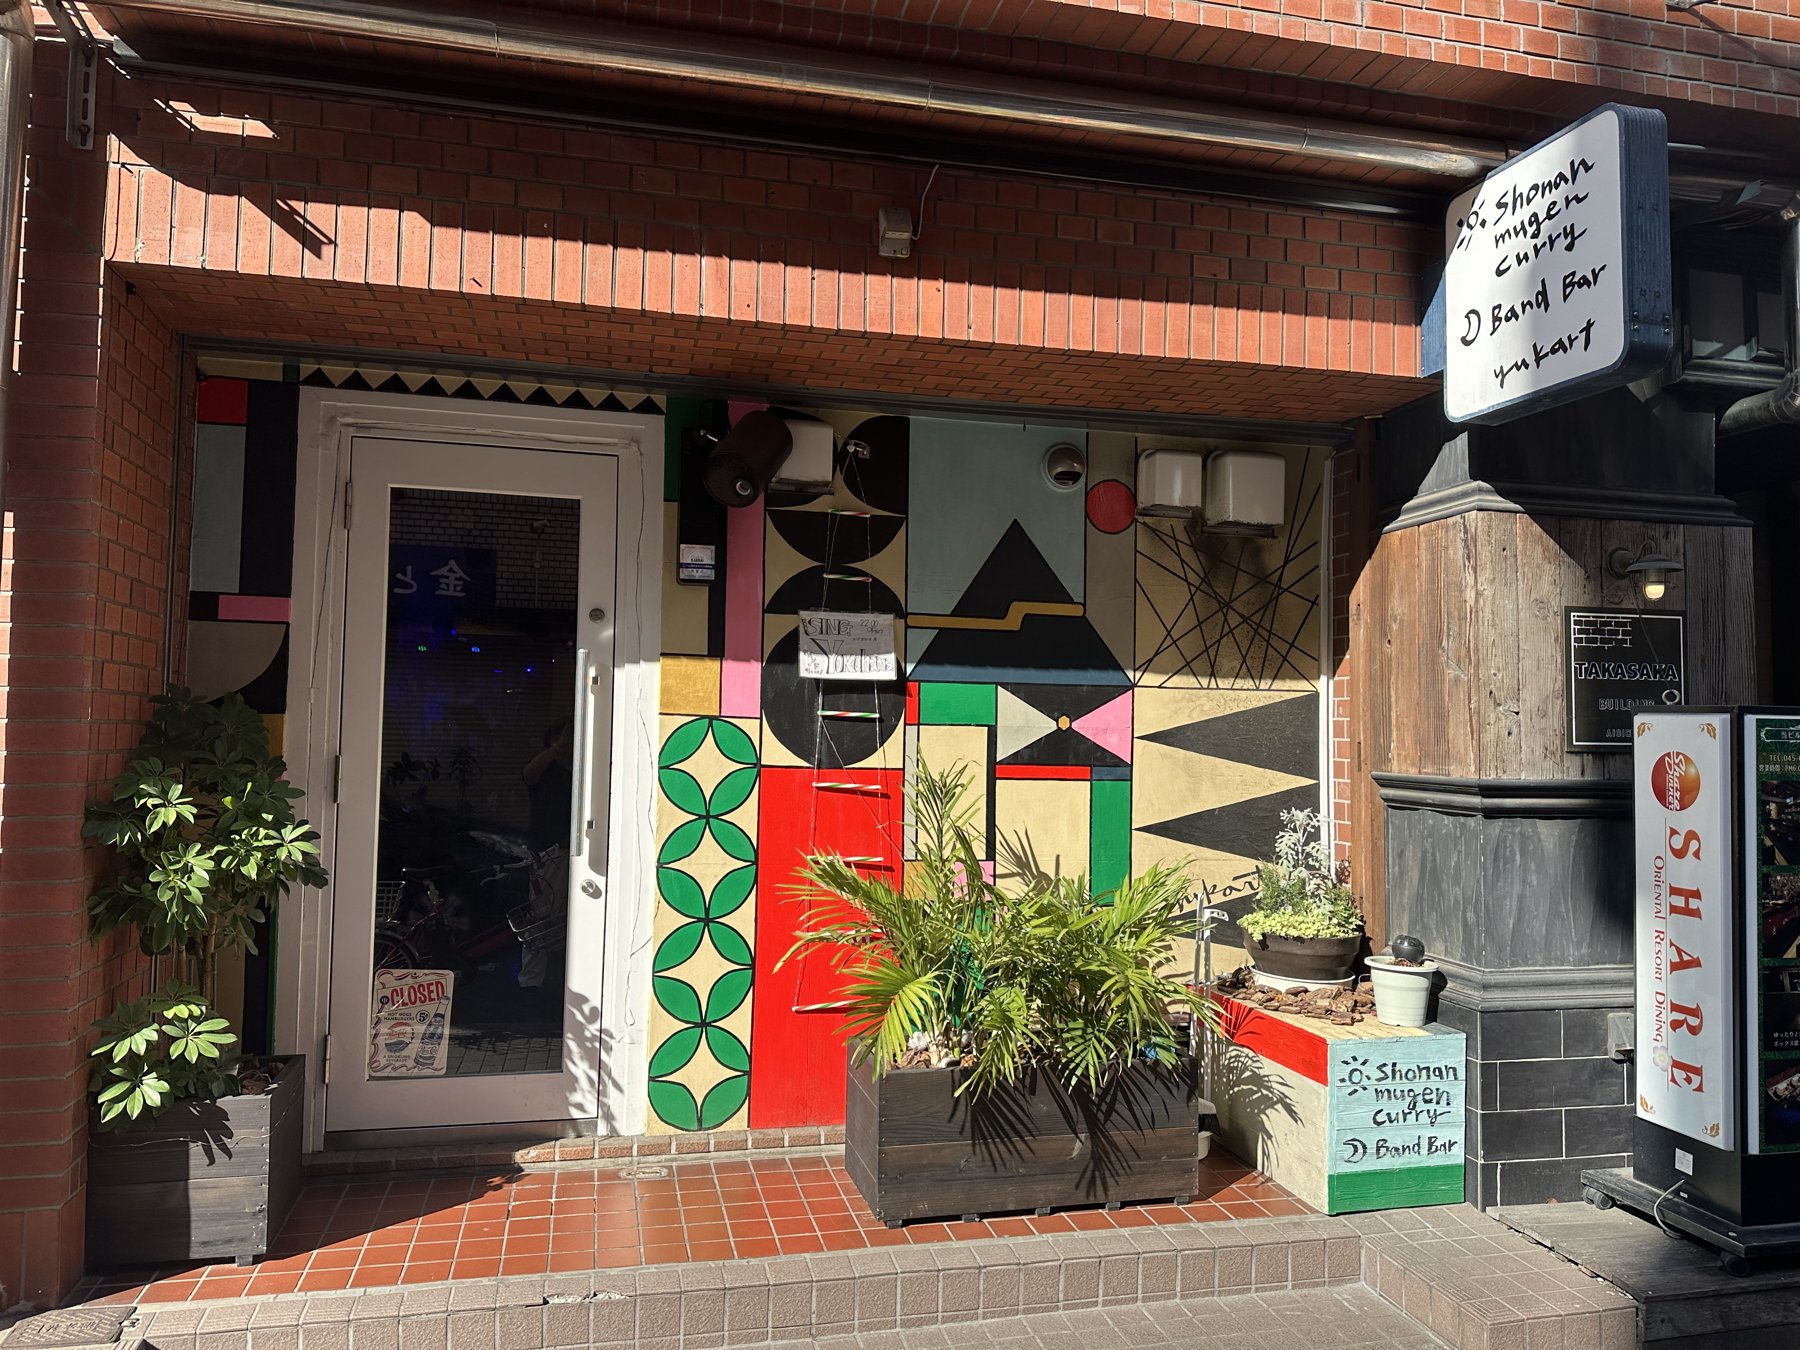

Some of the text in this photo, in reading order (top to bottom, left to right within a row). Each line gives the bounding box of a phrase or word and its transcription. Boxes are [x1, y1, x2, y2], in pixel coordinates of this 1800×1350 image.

[1494, 191, 1589, 249] mugen
[1489, 264, 1607, 336] Band Bar
[1493, 318, 1595, 389] yukart
[1574, 661, 1679, 681] TAKASAKA
[1669, 826, 1704, 1092] SHARE
[390, 980, 445, 1009] CLOSED
[1374, 1061, 1459, 1083] Shonan
[1374, 1086, 1451, 1111] mugen
[1375, 1135, 1458, 1159] Band Bar
